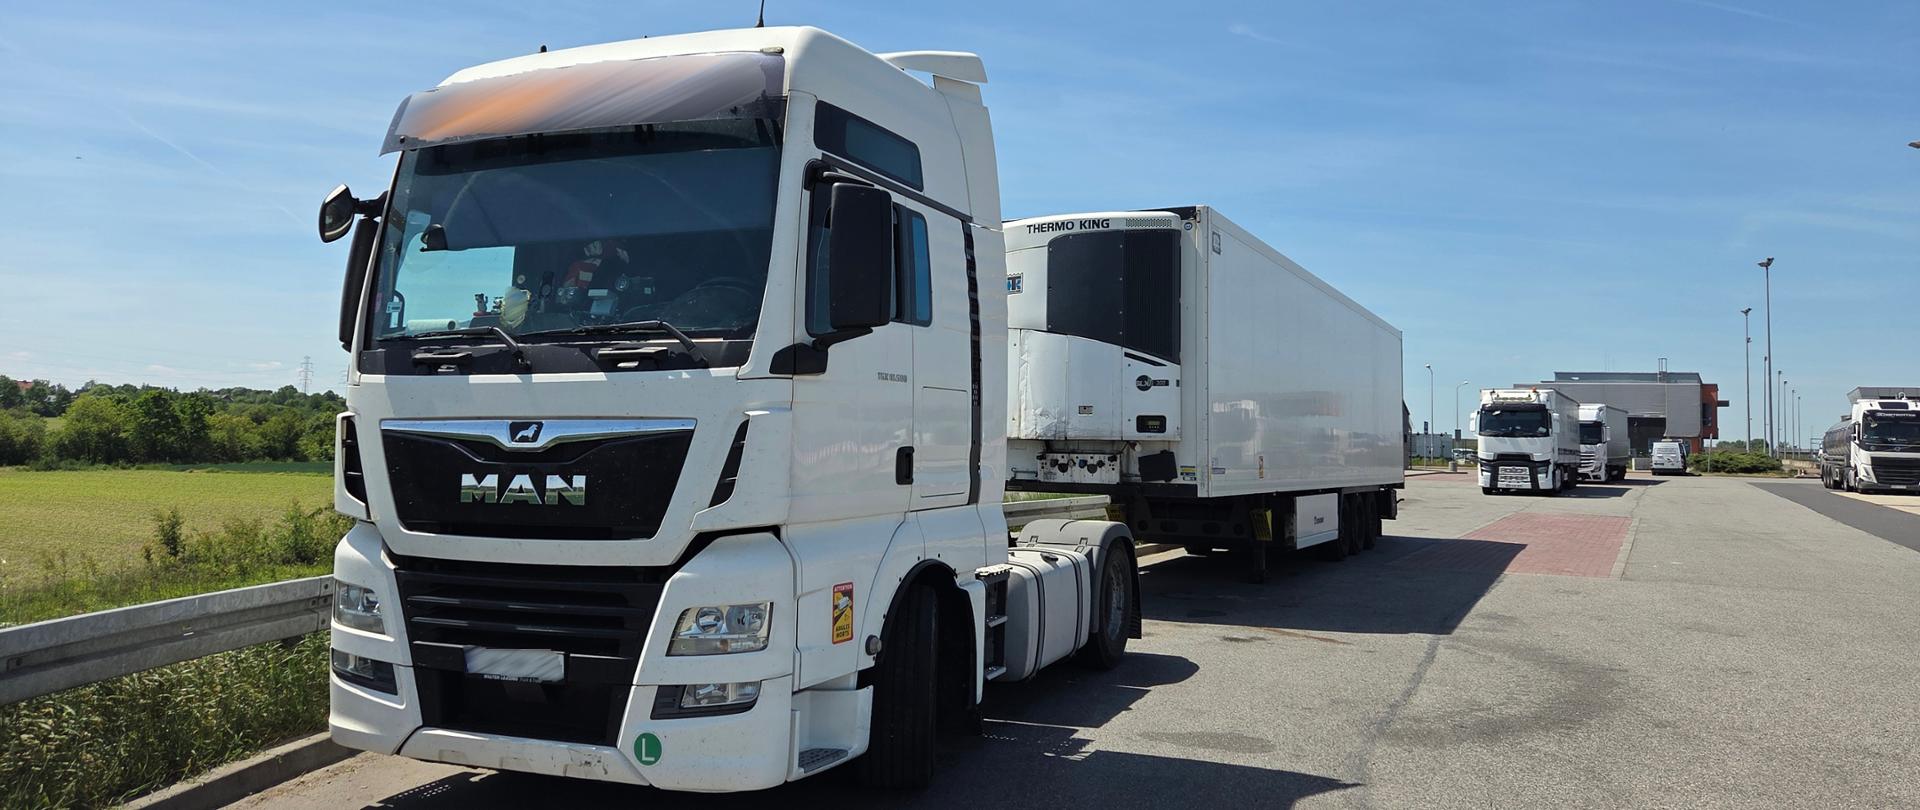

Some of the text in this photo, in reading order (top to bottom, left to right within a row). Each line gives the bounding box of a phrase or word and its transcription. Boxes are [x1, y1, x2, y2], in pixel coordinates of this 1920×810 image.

[1027, 218, 1110, 234] THERMO KING
[460, 473, 586, 505] MAN
[641, 738, 656, 761] L
